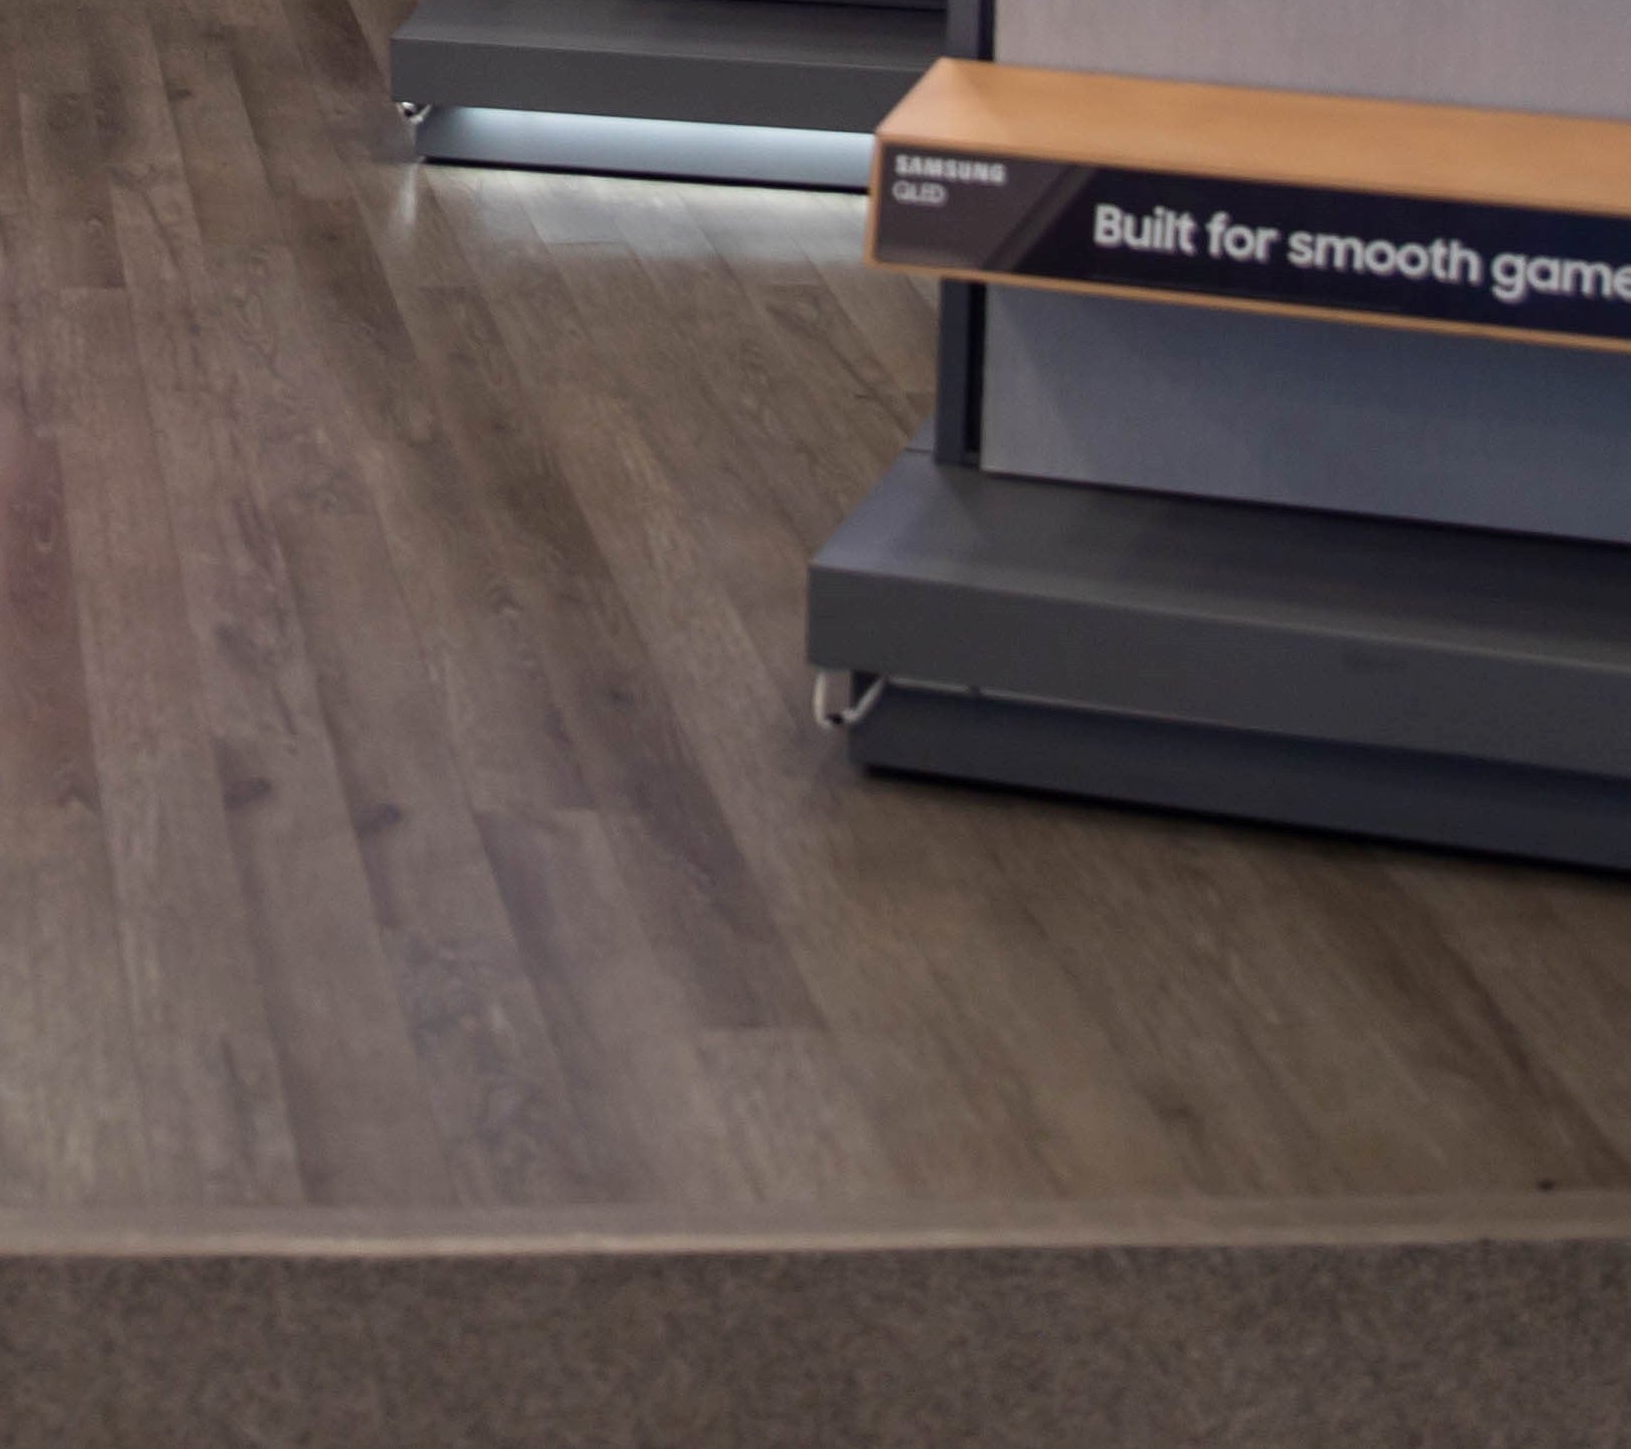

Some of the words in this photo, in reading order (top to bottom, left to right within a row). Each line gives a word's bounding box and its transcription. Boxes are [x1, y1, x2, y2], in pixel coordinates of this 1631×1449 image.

[894, 153, 1006, 186] SAMSUNG
[892, 180, 948, 206] QLED
[1093, 203, 1196, 255] Built
[1205, 210, 1279, 261] for
[1287, 226, 1480, 286] smooth
